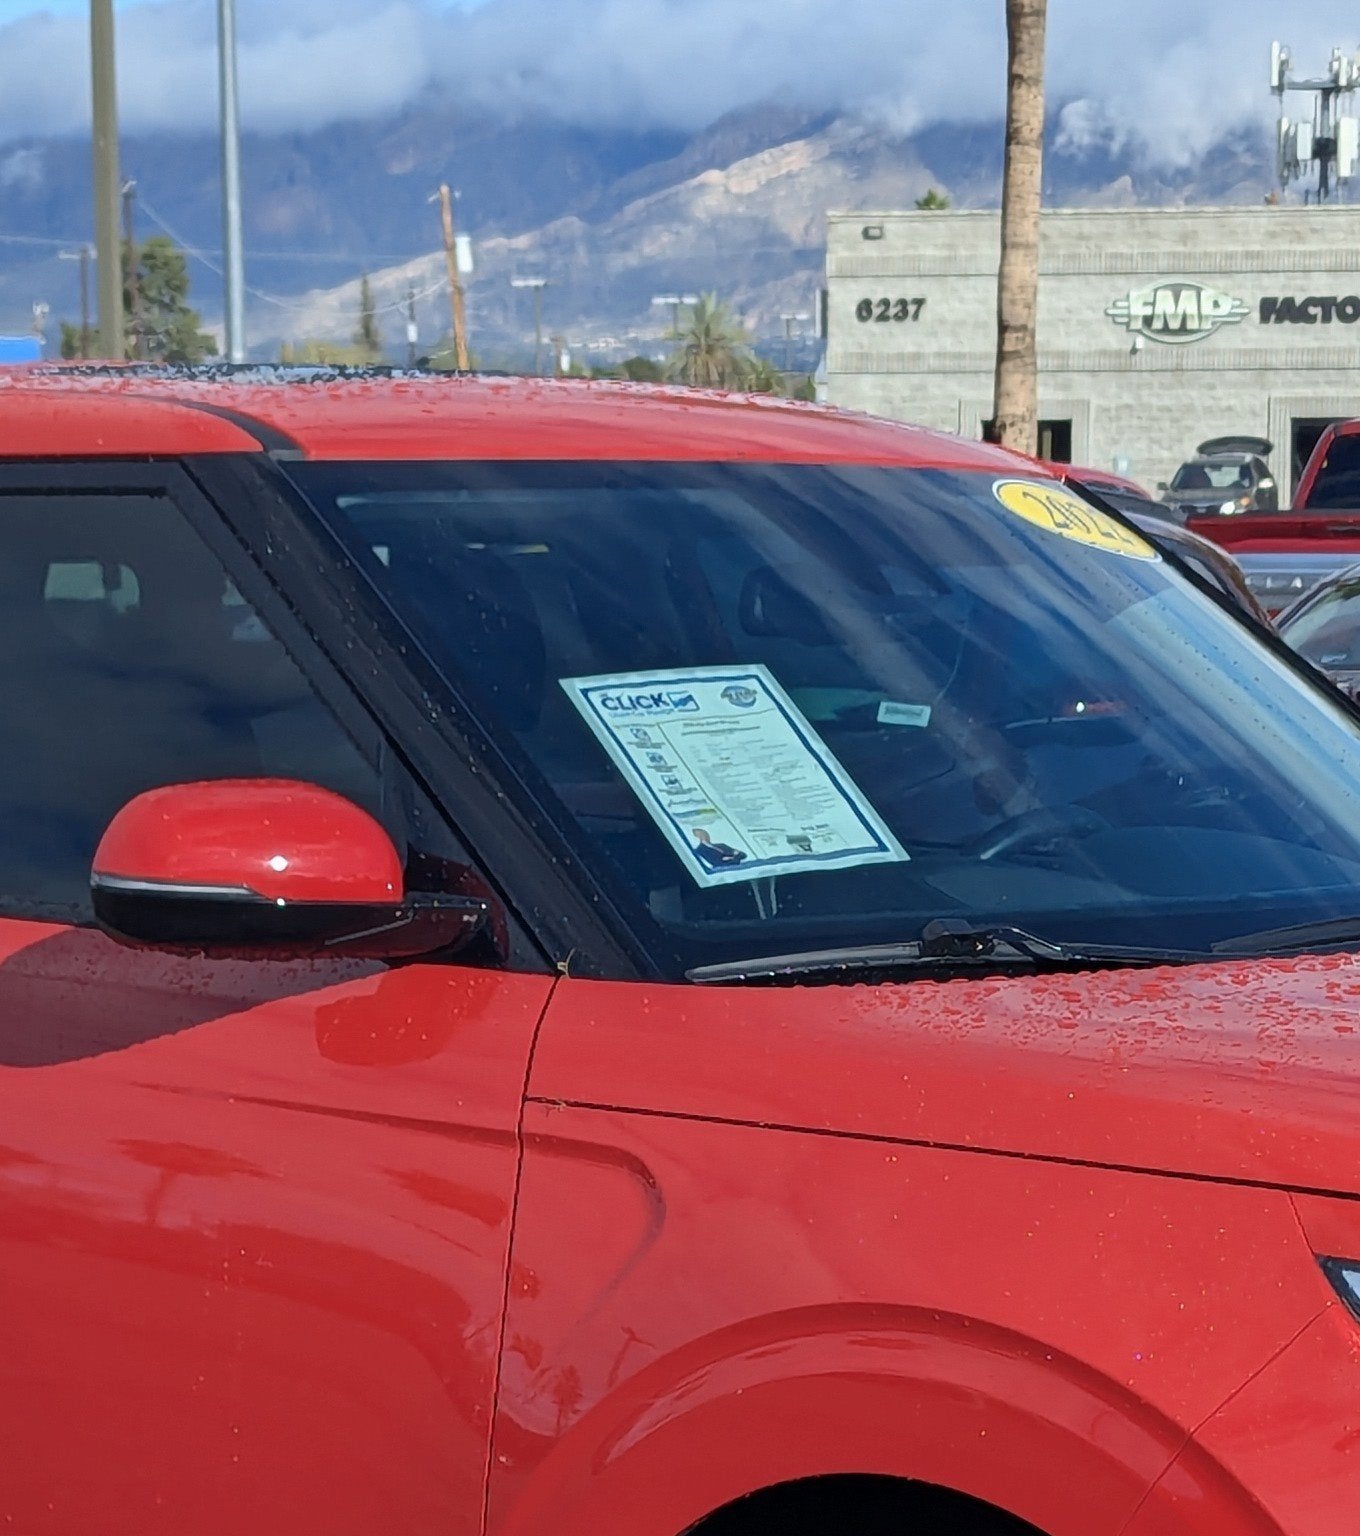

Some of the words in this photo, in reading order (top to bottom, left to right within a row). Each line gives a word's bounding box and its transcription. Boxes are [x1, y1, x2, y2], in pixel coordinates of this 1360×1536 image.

[855, 297, 926, 323] 6237
[1128, 288, 1234, 331] FMP
[601, 692, 670, 712] CLICK
